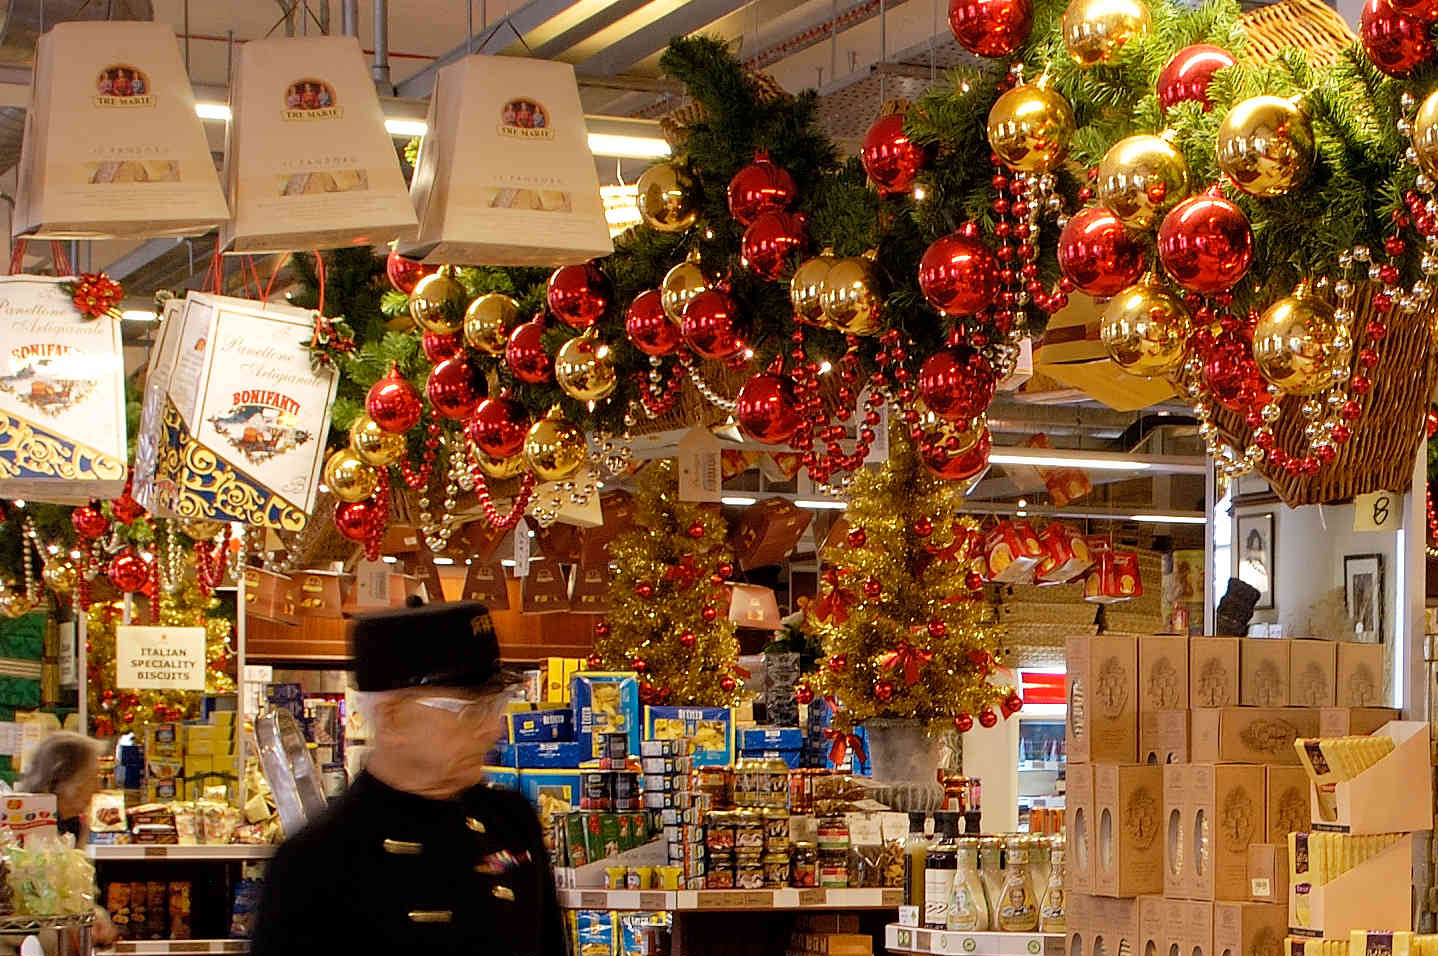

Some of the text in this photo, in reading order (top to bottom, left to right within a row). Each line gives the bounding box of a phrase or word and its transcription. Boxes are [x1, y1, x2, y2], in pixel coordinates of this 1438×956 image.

[232, 389, 300, 415] BONIFANTI
[141, 648, 186, 656] ITALIAN
[130, 660, 196, 668] SPECIALITY
[138, 672, 190, 680] BISCUITS
